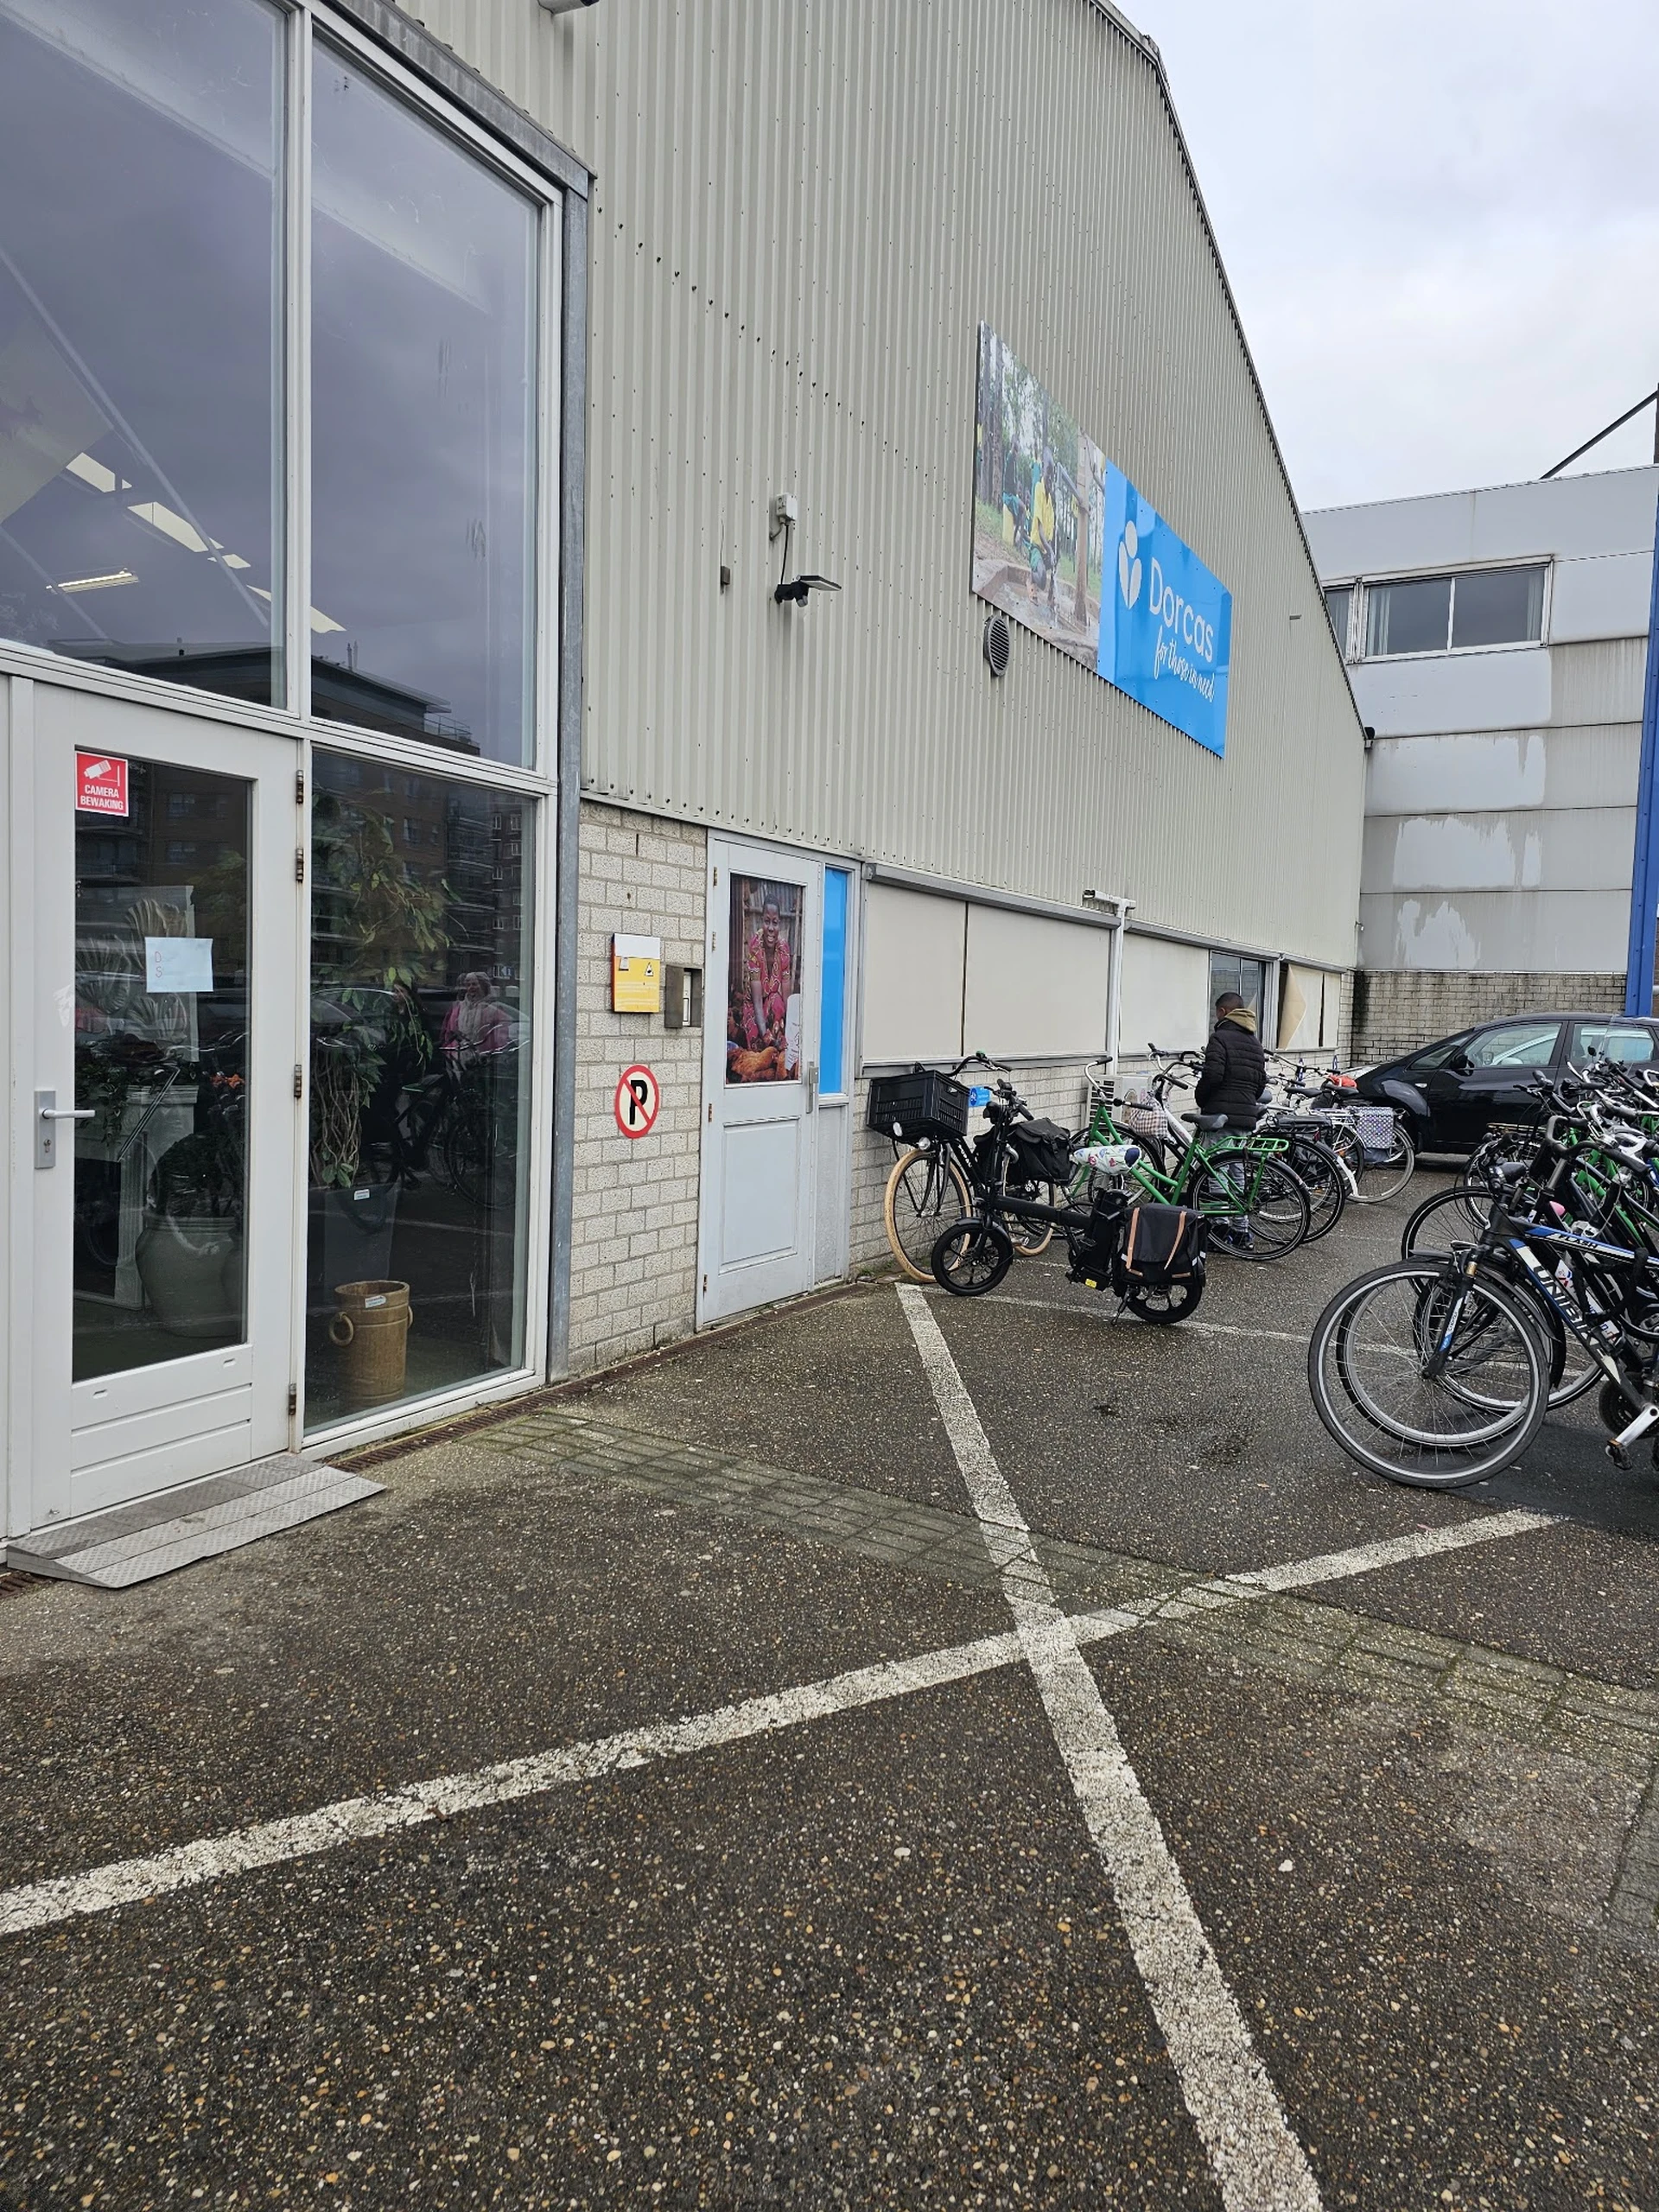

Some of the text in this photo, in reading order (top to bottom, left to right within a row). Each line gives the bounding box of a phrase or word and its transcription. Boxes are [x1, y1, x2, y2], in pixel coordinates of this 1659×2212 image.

[1149, 557, 1214, 663] Dorcas
[1154, 625, 1168, 680] for
[1168, 638, 1189, 682] those
[1197, 672, 1215, 702] need
[80, 795, 124, 810] BEWAKING
[85, 785, 119, 798] CAMERA
[629, 1079, 648, 1125] P
